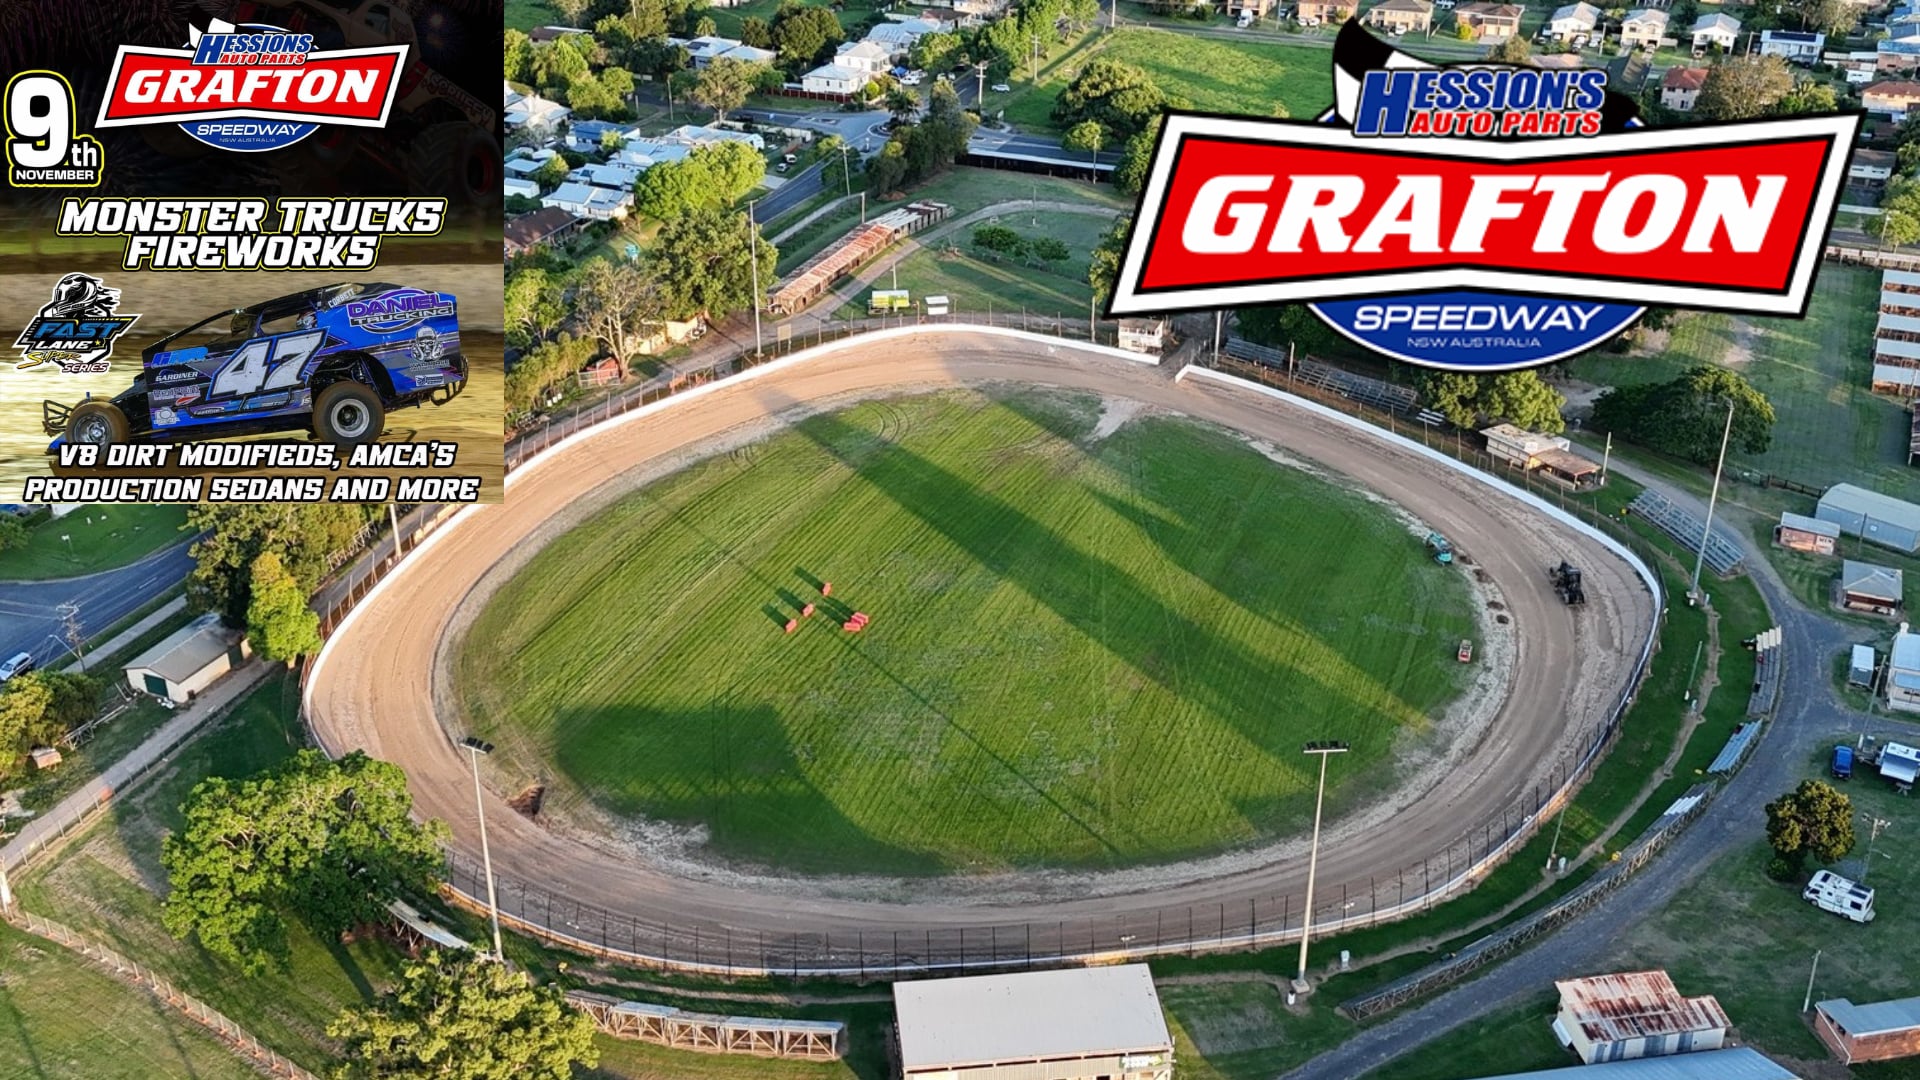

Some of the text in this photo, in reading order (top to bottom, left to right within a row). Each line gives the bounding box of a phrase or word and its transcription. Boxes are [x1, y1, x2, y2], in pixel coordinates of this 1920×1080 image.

[346, 291, 451, 318] DANIEL
[353, 308, 451, 325] TRUCKING
[210, 331, 324, 397] 47
[155, 371, 198, 382] GARDINER
